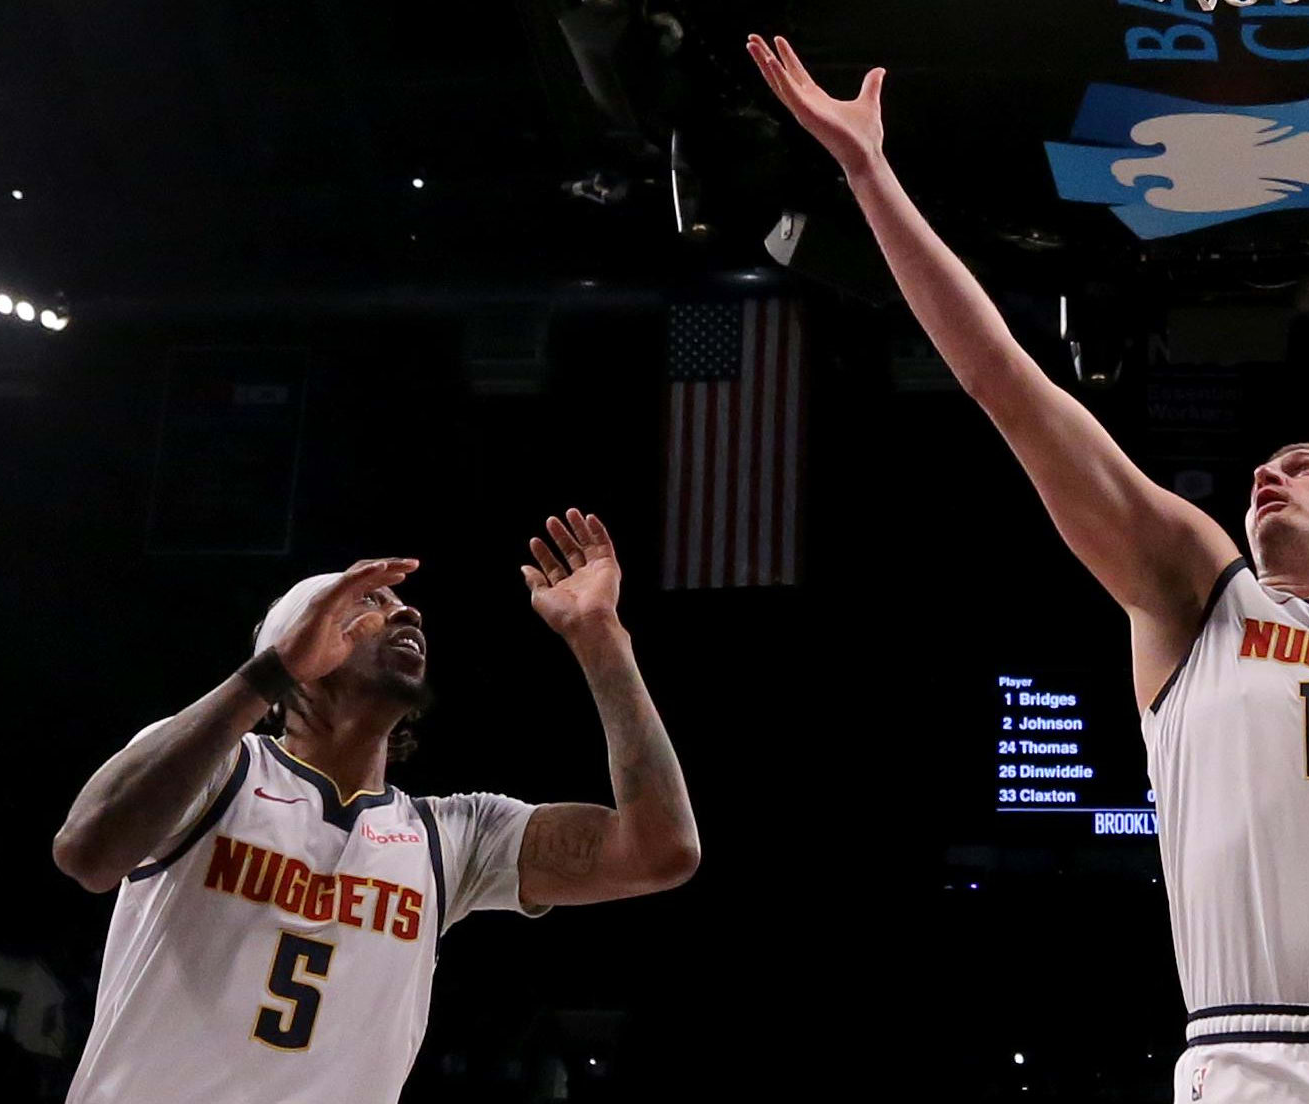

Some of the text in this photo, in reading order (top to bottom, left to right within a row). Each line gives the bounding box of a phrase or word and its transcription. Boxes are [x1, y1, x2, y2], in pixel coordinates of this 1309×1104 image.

[999, 676, 1032, 689] Player
[1004, 693, 1076, 708] 1 Bridges
[1003, 717, 1082, 730] 2 Johnson
[999, 741, 1078, 754] 24 Thomas
[999, 765, 1093, 778] 26 Dinwiddie
[999, 790, 1016, 802] 33
[1019, 789, 1076, 802] Claxton
[204, 835, 425, 943] NUGGETS
[249, 928, 338, 1052] 5
